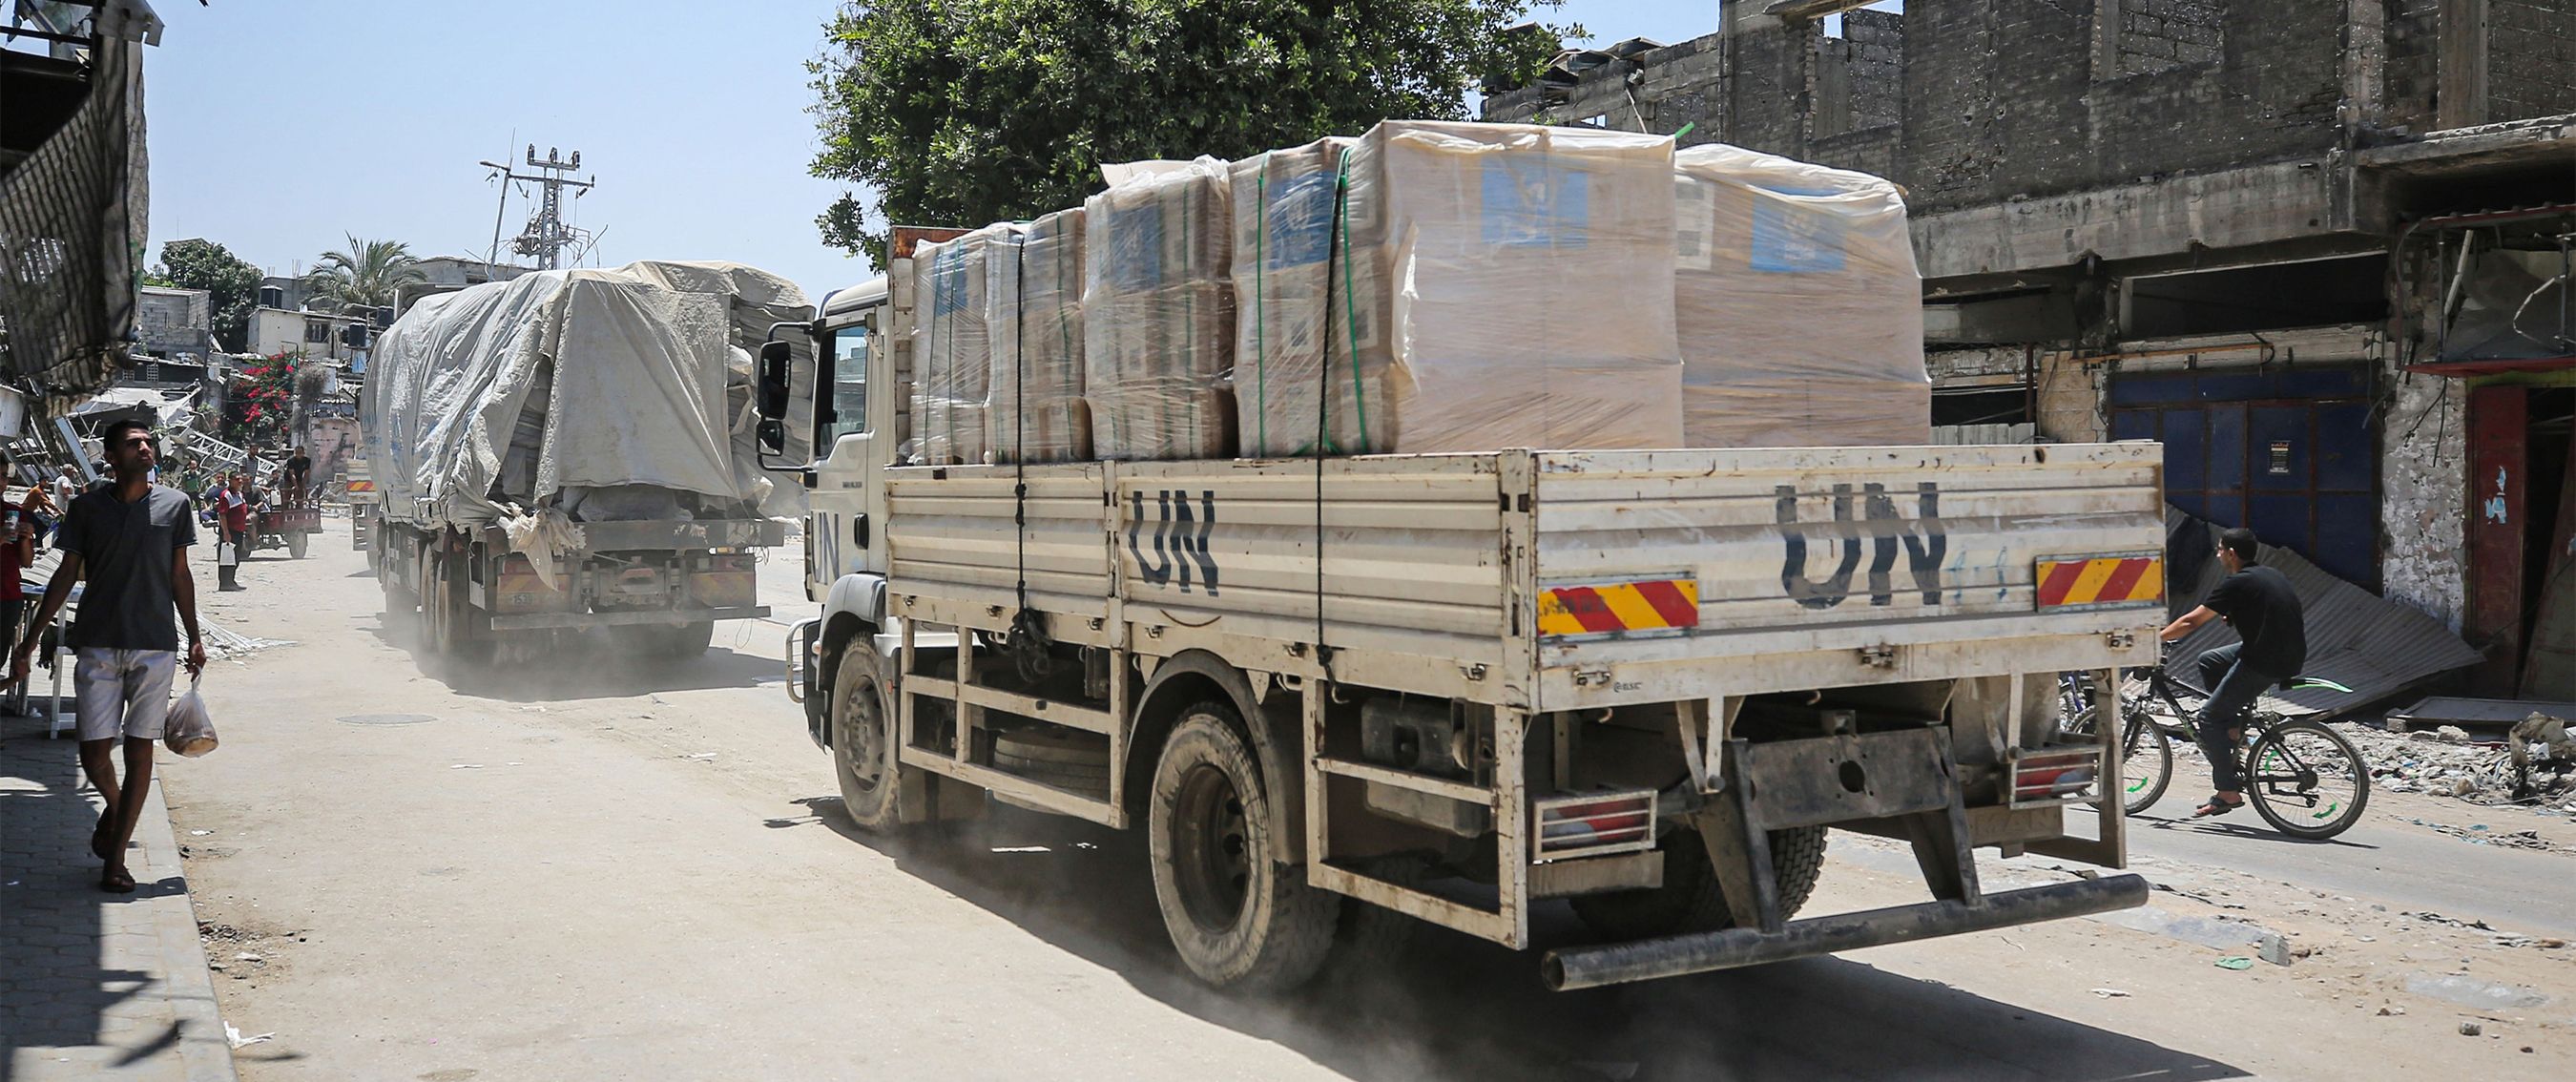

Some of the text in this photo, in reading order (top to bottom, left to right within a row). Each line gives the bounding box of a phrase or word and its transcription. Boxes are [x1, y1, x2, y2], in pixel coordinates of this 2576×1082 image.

[811, 511, 840, 585] UN
[1129, 490, 1218, 596] UN
[1776, 482, 1946, 609] UN
